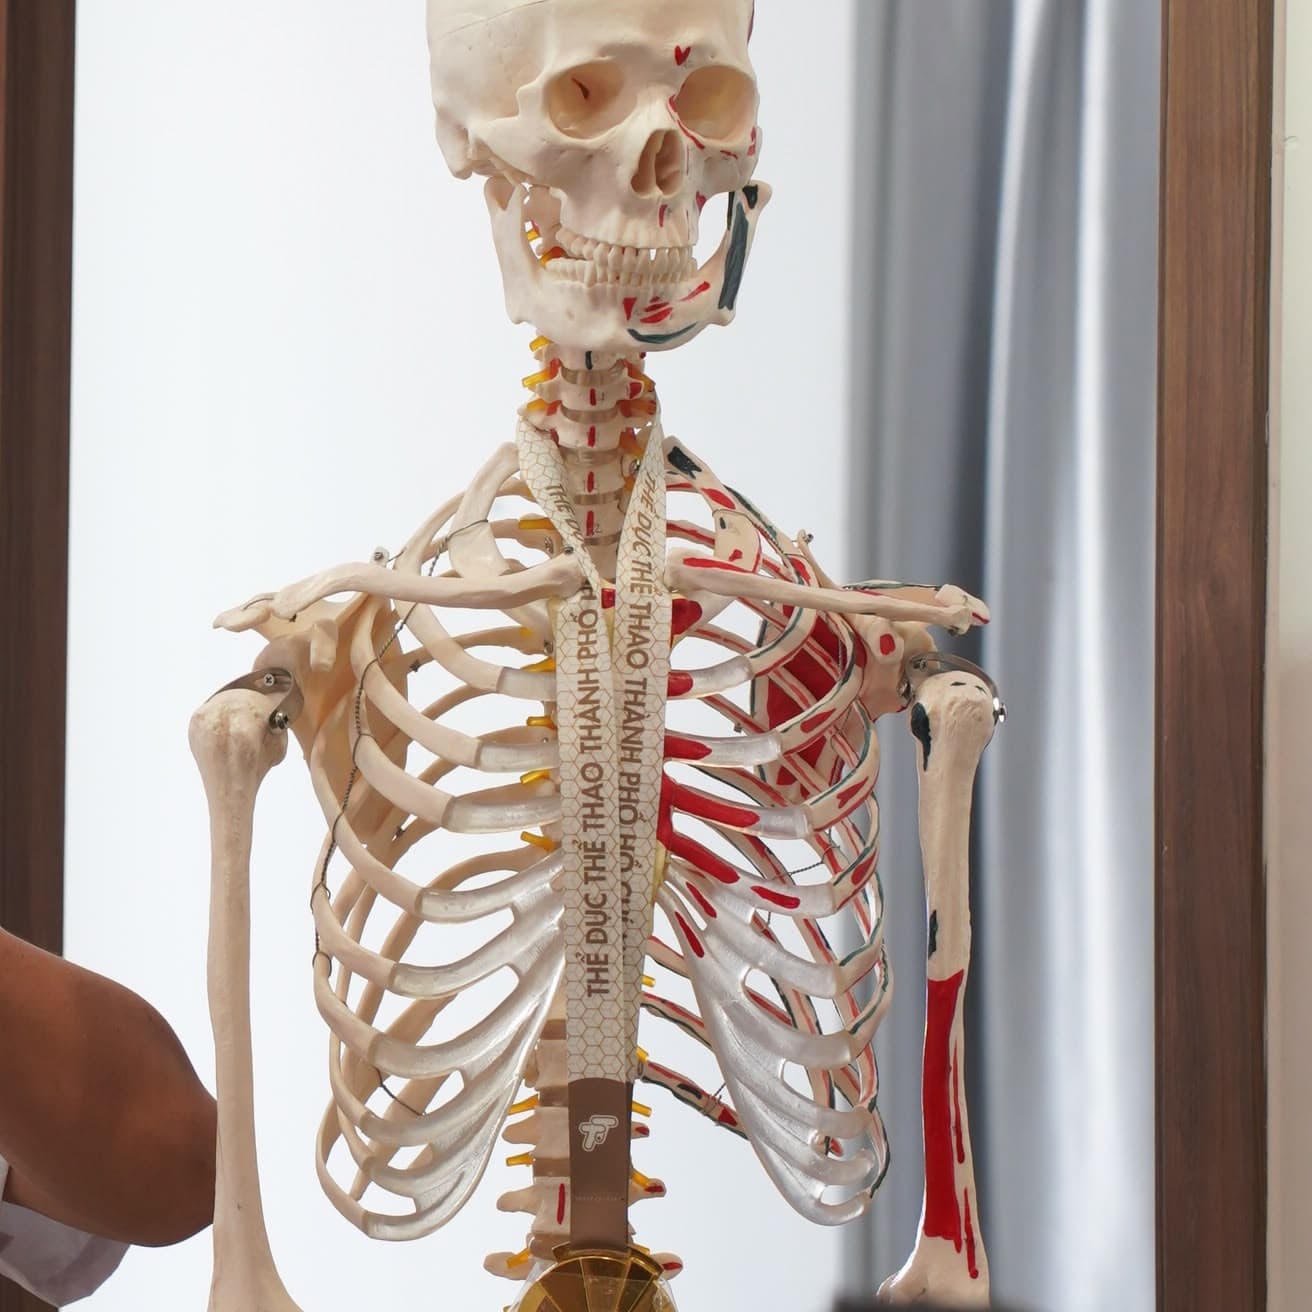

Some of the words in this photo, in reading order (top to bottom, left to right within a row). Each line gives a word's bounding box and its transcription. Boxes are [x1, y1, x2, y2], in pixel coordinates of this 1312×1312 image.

[570, 608, 599, 660] PHỐ
[626, 602, 651, 669] THAO
[573, 668, 602, 754] THÀNH
[620, 677, 651, 763] THÀNH
[581, 762, 606, 832] THAO
[572, 839, 606, 885] THỂ
[584, 892, 612, 944] DỤC
[575, 951, 610, 997] THỂ
